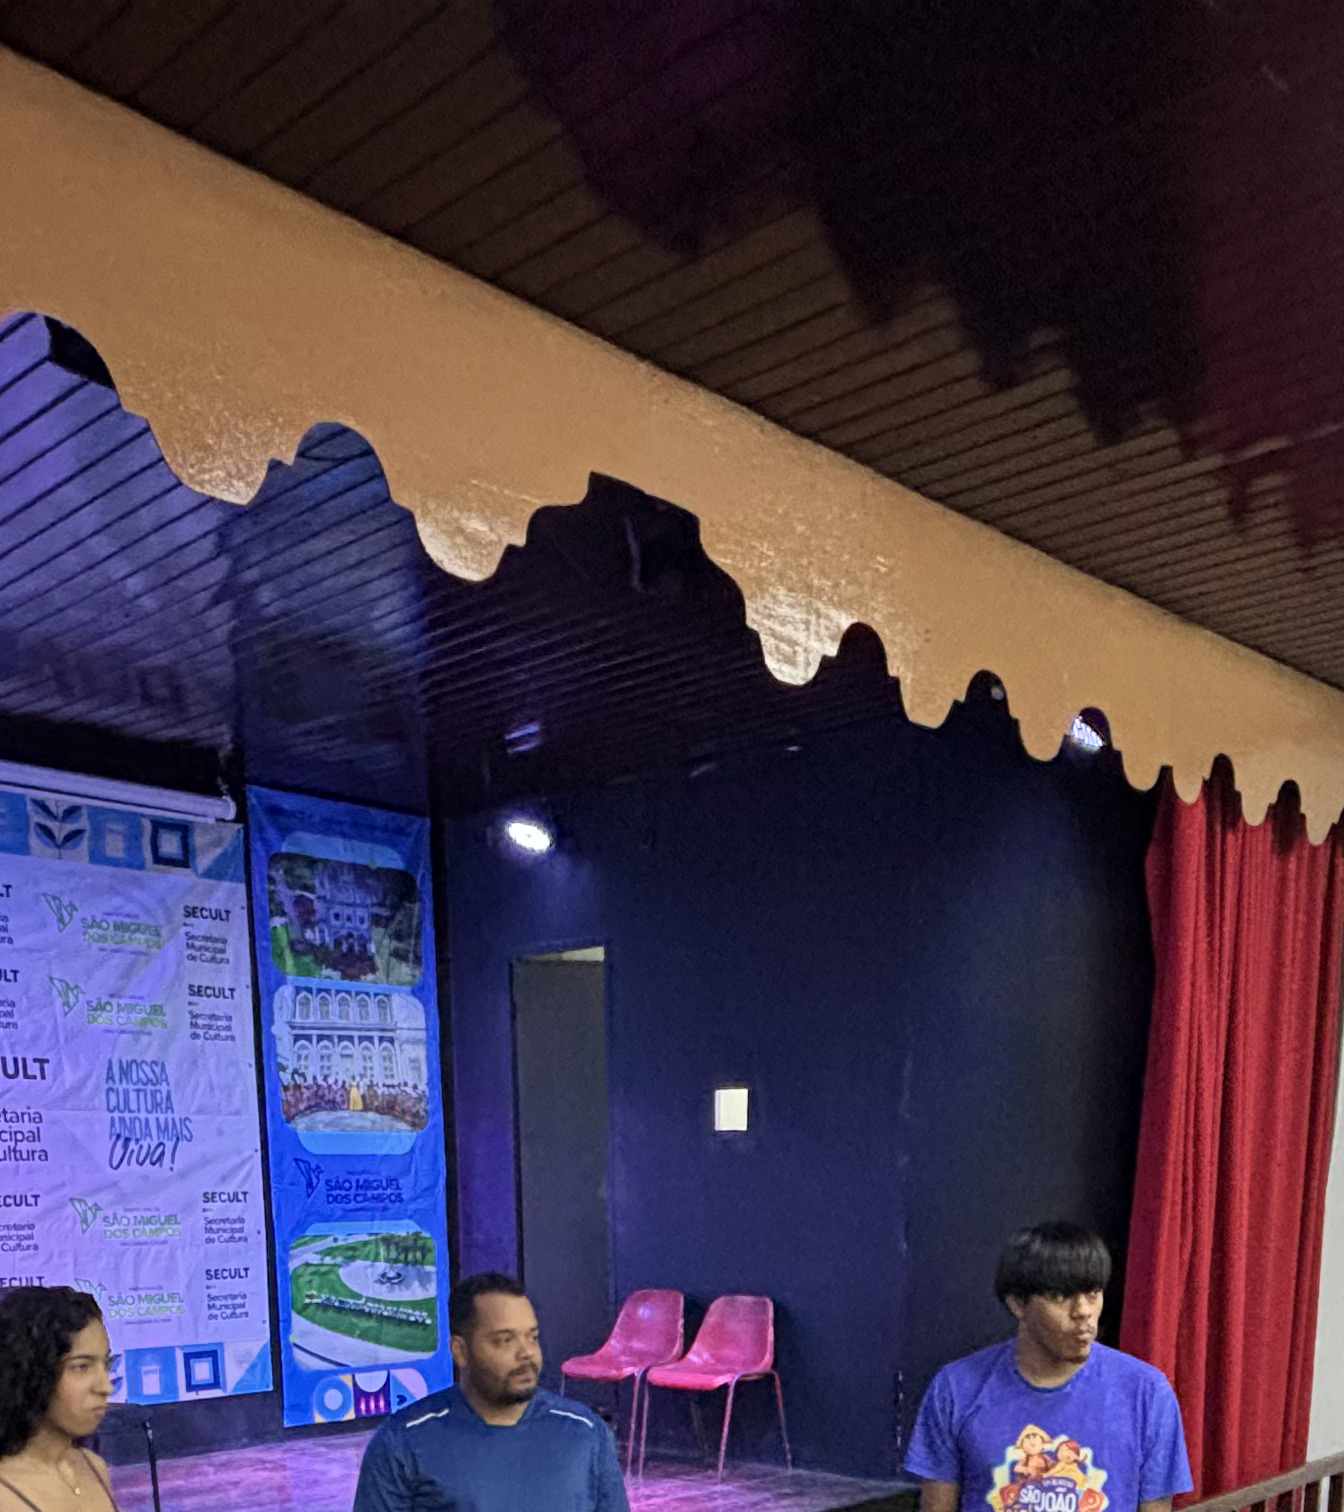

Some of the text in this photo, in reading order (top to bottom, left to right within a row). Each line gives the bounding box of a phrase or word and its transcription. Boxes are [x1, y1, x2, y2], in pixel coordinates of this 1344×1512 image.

[183, 905, 231, 922] SECULT
[188, 984, 235, 1000] SECULT
[106, 1058, 170, 1087] A NOSSA
[106, 1086, 175, 1115] CULTURA
[109, 1115, 194, 1143] AINDA MAIS
[202, 1191, 249, 1203] SECULT
[1, 1243, 39, 1252] Cultura
[205, 1267, 250, 1281] SECULT
[1020, 1485, 1076, 1512] SÃO JOÃO
